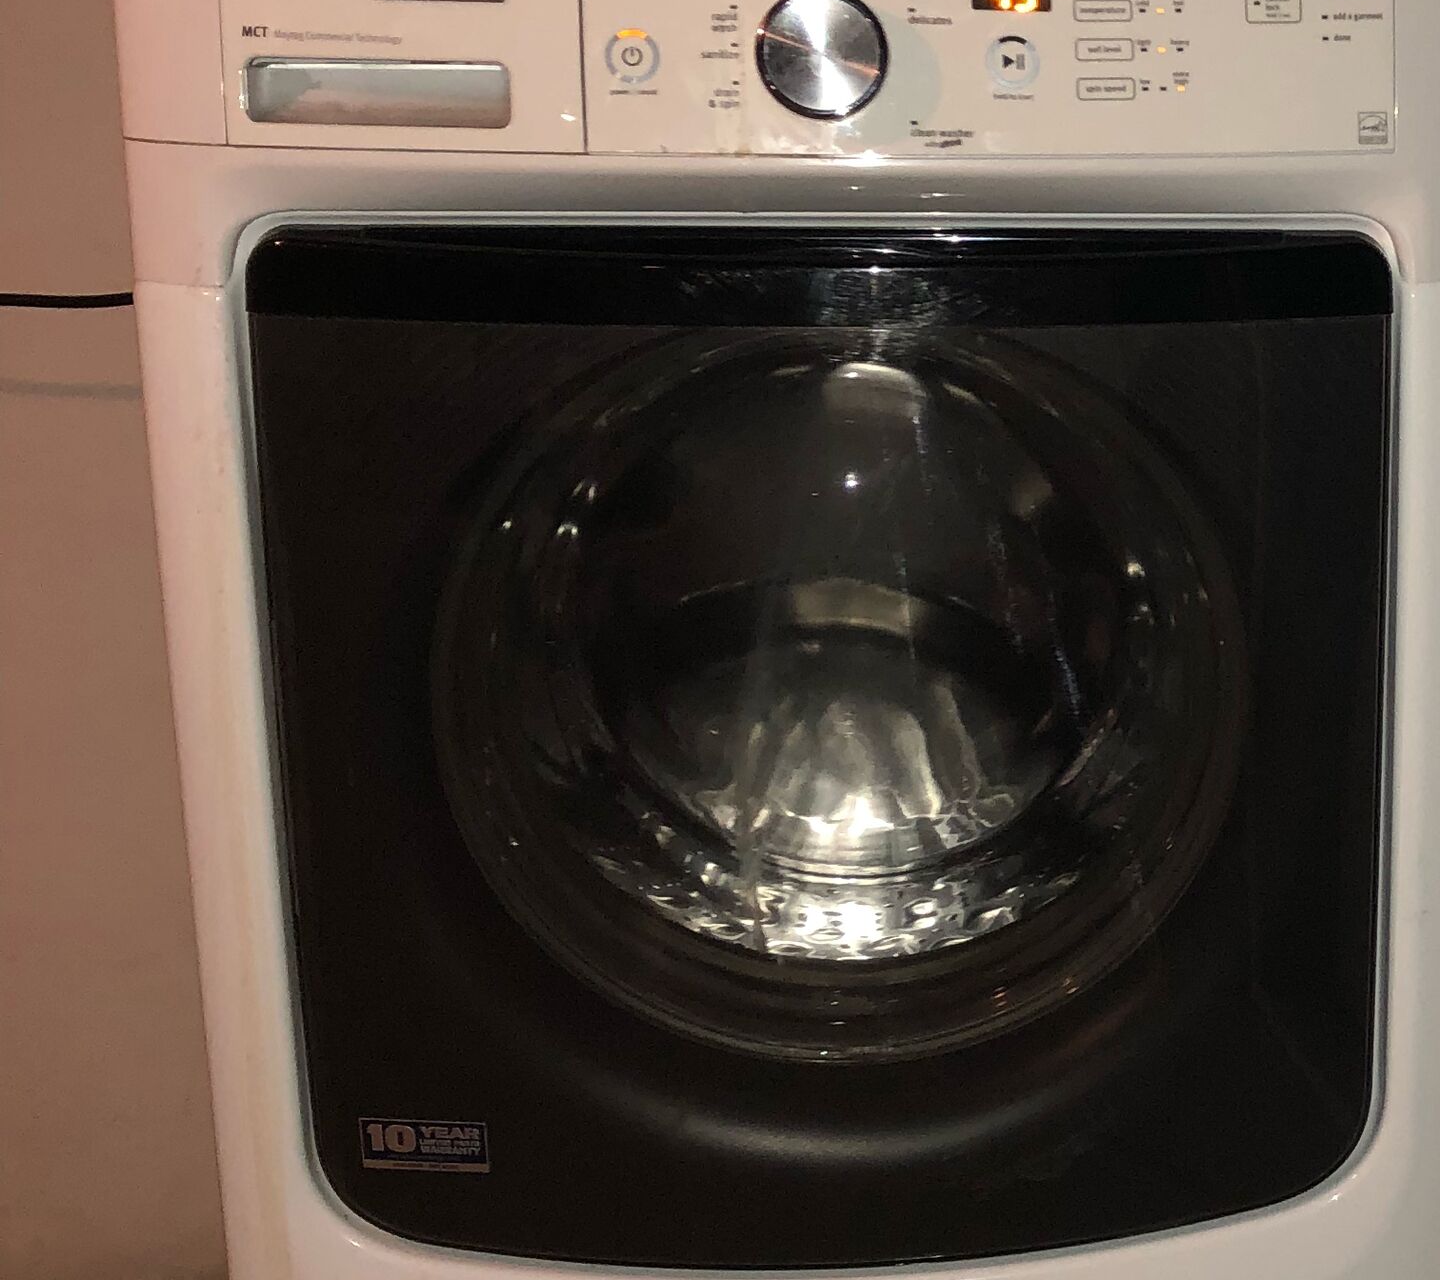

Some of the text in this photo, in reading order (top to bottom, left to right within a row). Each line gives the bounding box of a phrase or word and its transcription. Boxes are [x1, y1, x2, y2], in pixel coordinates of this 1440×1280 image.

[242, 25, 268, 38] MCT
[366, 1123, 481, 1153] 10 YEAR
